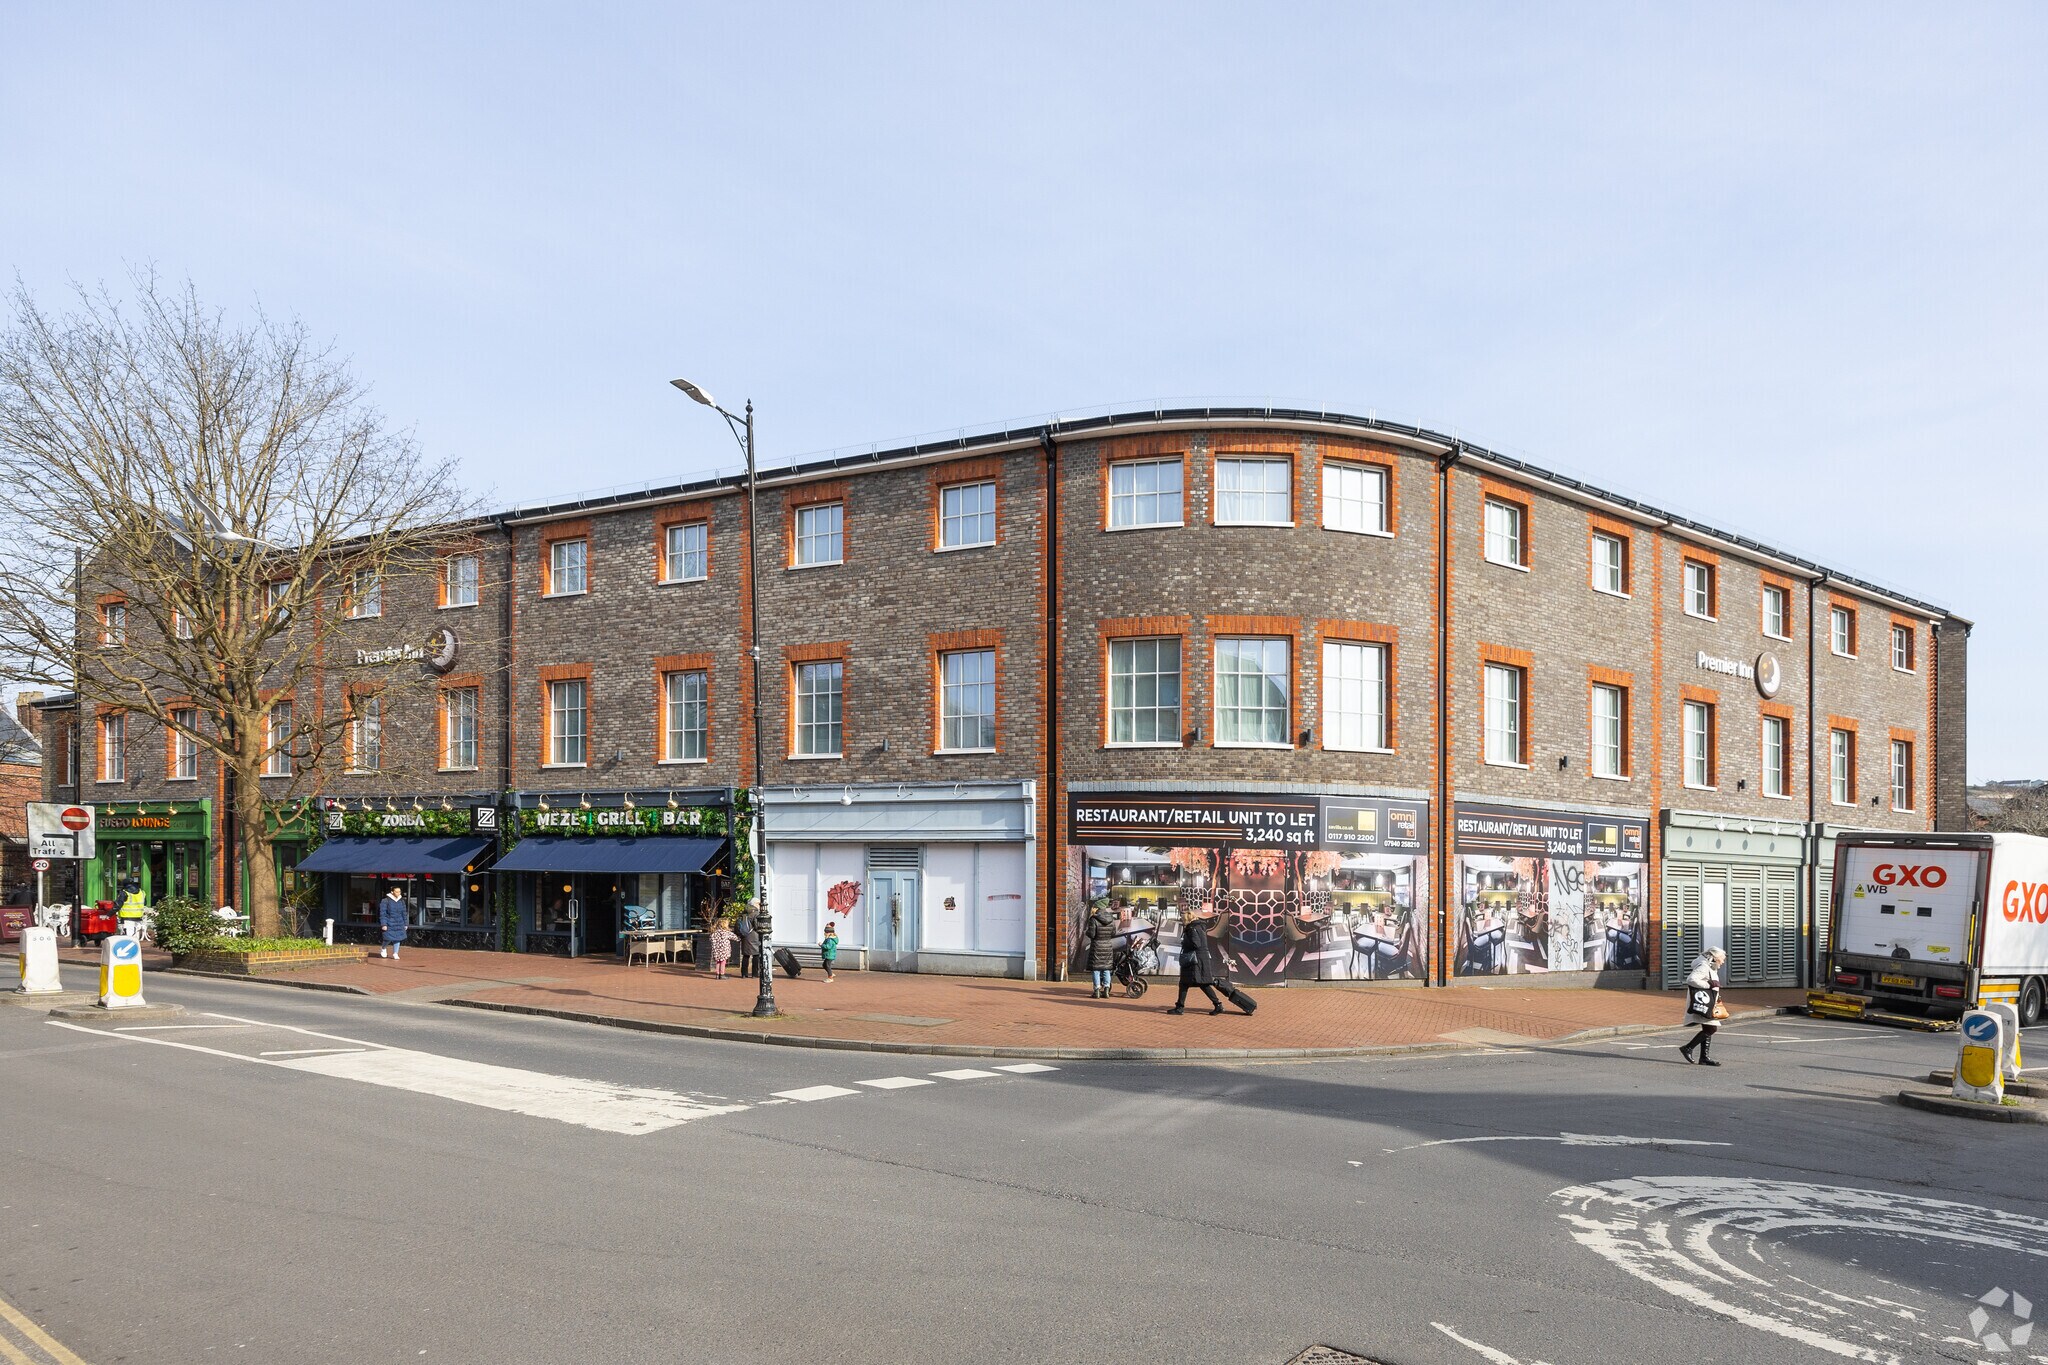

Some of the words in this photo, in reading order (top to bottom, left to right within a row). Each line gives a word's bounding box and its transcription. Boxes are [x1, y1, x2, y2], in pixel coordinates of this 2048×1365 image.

[1697, 650, 1738, 676] Premier
[1739, 660, 1755, 679] Inn
[100, 817, 131, 828] FUEGO
[131, 817, 171, 828] LOUNGE
[381, 814, 425, 827] ZORBA
[537, 812, 580, 826] MEZE
[597, 811, 644, 826] GRILL
[663, 811, 701, 826] BAR
[1076, 808, 1225, 825] RESTAURANT/RETAIL
[1228, 811, 1262, 825] UNIT
[1266, 811, 1286, 826] TO
[1290, 812, 1316, 827] LET
[1390, 812, 1415, 822] omni
[1397, 821, 1415, 830] retail
[1458, 819, 1539, 837] RESTAURANT/RETAIL
[1540, 825, 1557, 838] UNIT
[1559, 827, 1568, 839] TO
[1569, 828, 1583, 840] LET
[1245, 828, 1284, 844] 3,240
[1286, 831, 1302, 845] sq
[1304, 829, 1315, 844] ft
[1328, 832, 1342, 840] 0117
[1343, 833, 1356, 841] 910
[1357, 834, 1375, 842] 2200
[1383, 840, 1401, 848] 07940
[1547, 841, 1567, 854] 3,240
[1567, 844, 1576, 856] sq
[1576, 842, 1583, 855] ft
[1872, 863, 1948, 888] GXO
[1866, 884, 1888, 894] WB
[2002, 879, 2048, 924] GXO
